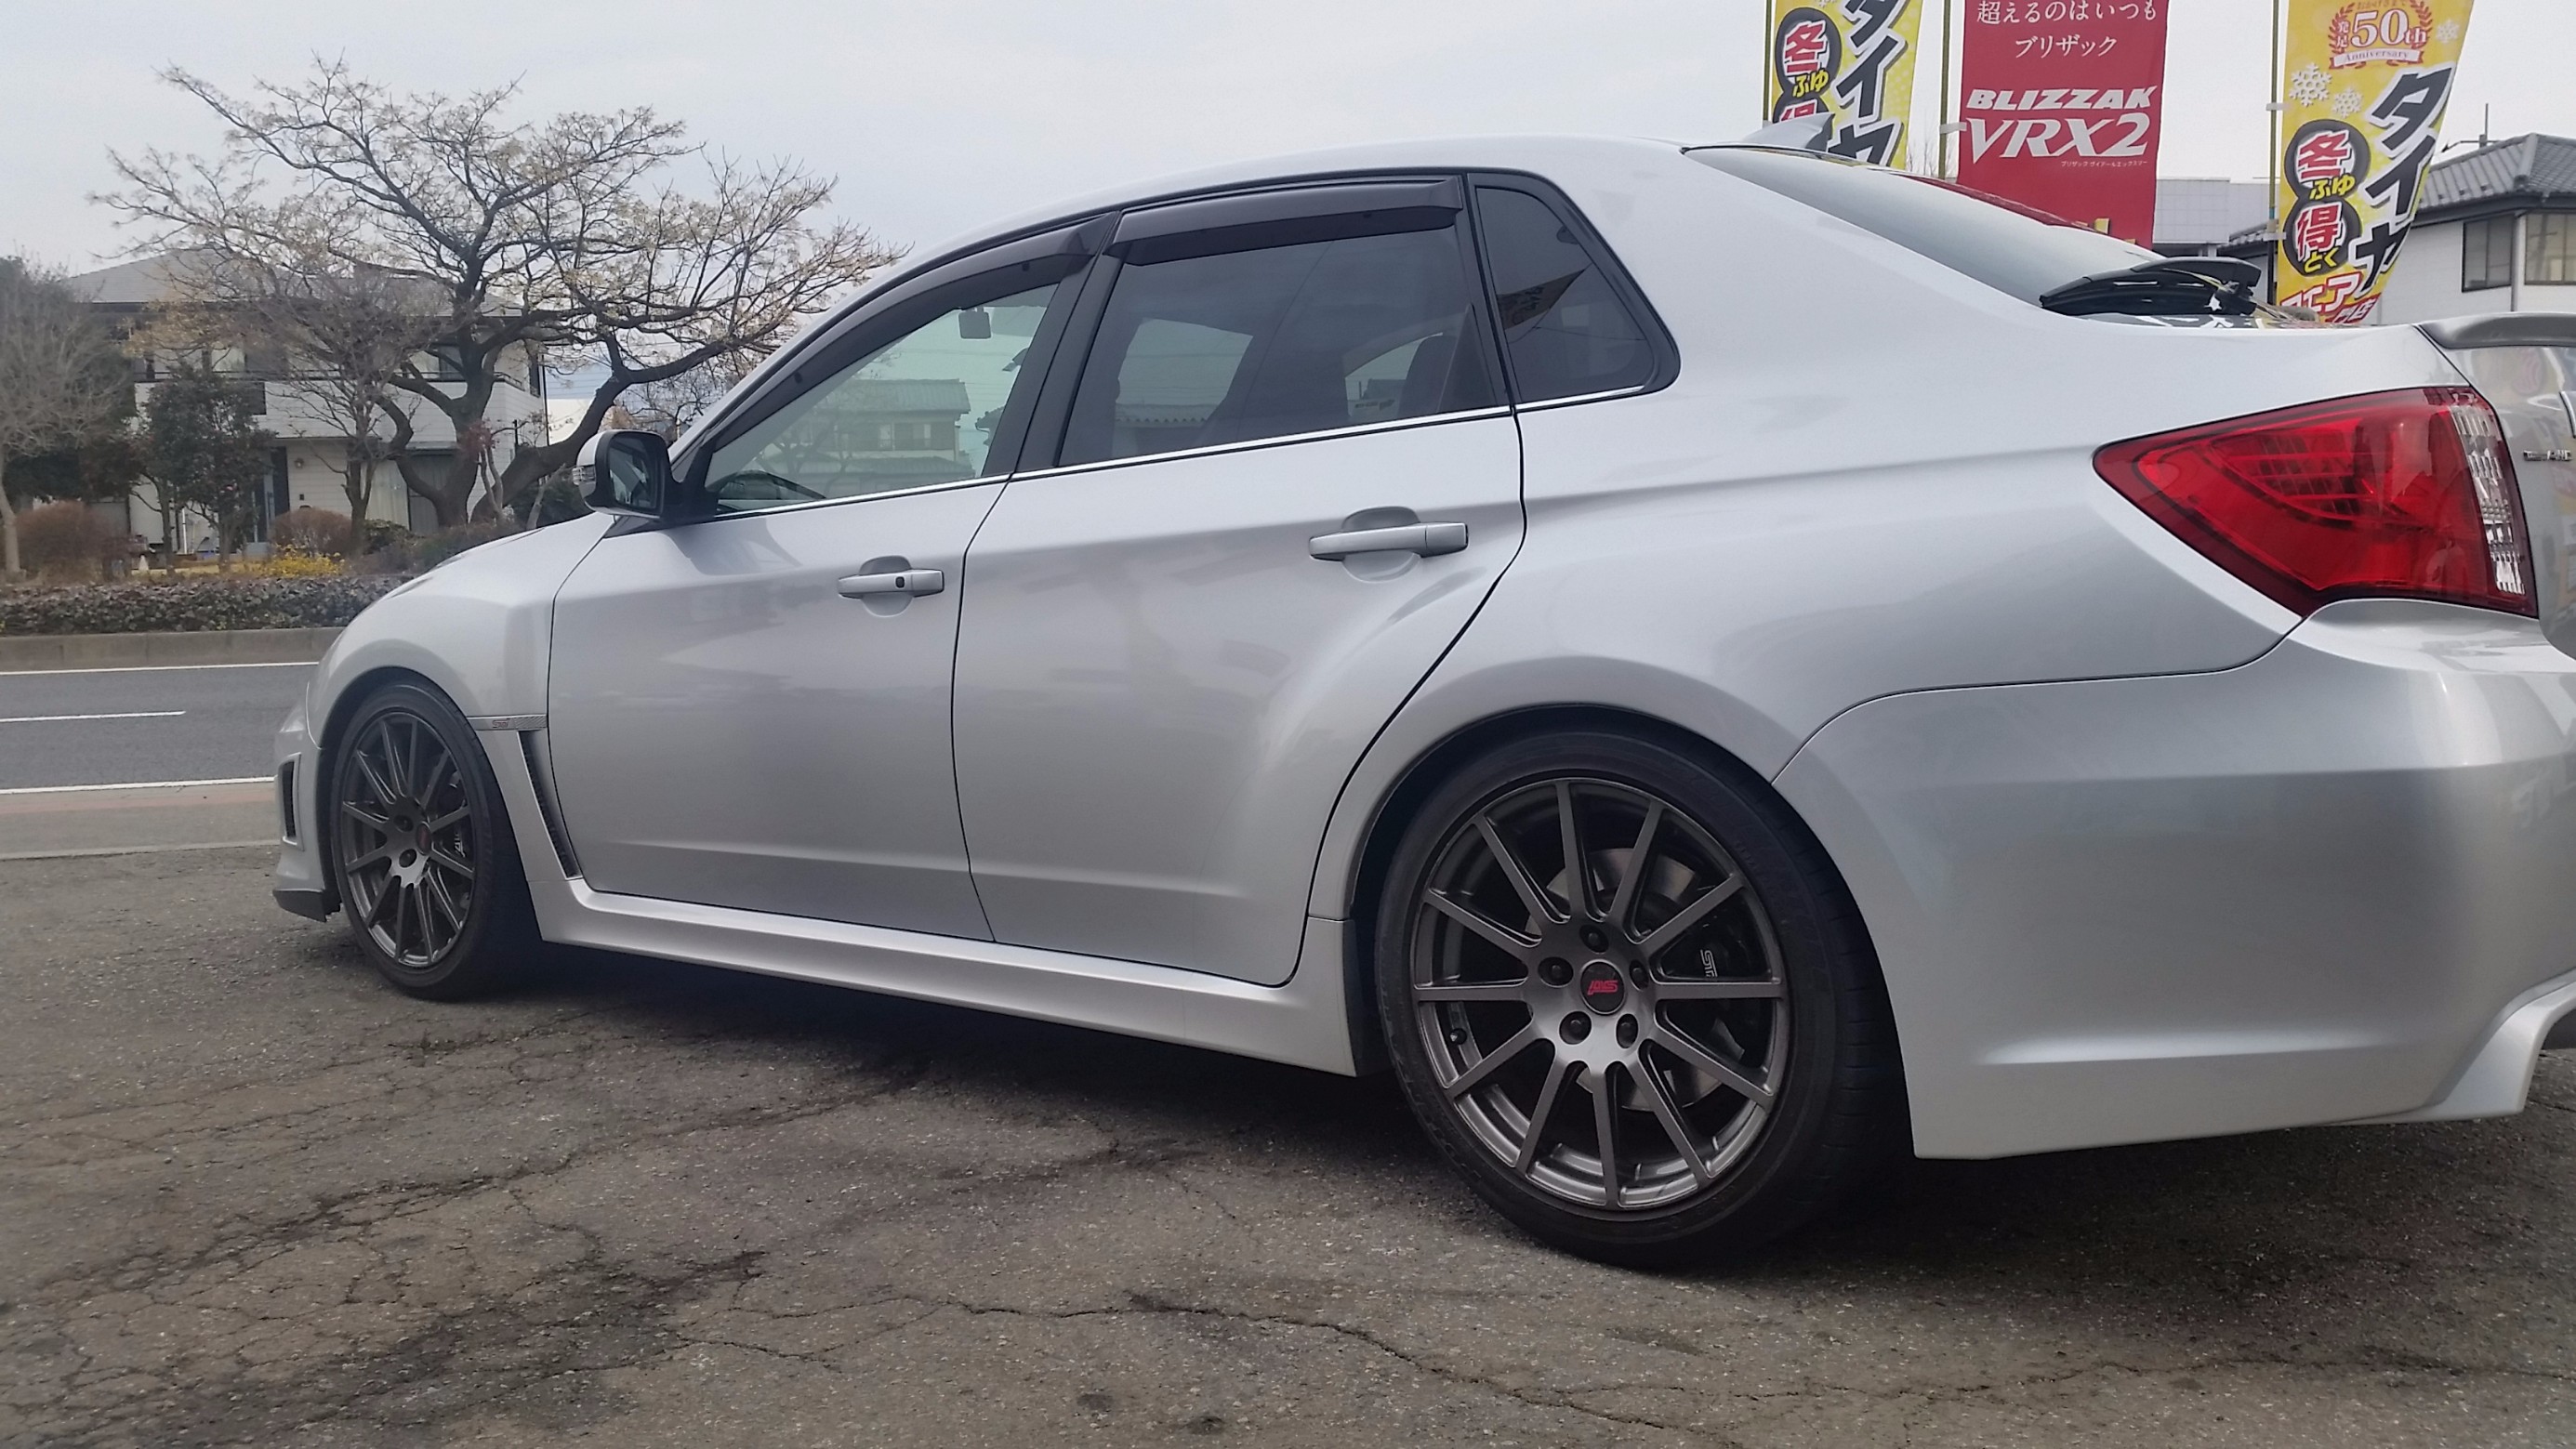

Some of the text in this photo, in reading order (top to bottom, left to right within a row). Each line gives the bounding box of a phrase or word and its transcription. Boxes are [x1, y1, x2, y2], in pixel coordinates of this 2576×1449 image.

[1976, 0, 2158, 24] 超えるのはいつも
[2351, 8, 2428, 48] 50th
[2015, 33, 2118, 59] ブリザック
[2343, 49, 2410, 62] Anniversary
[1966, 85, 2158, 111] BLIZZAK
[1965, 112, 2151, 165] VRX2
